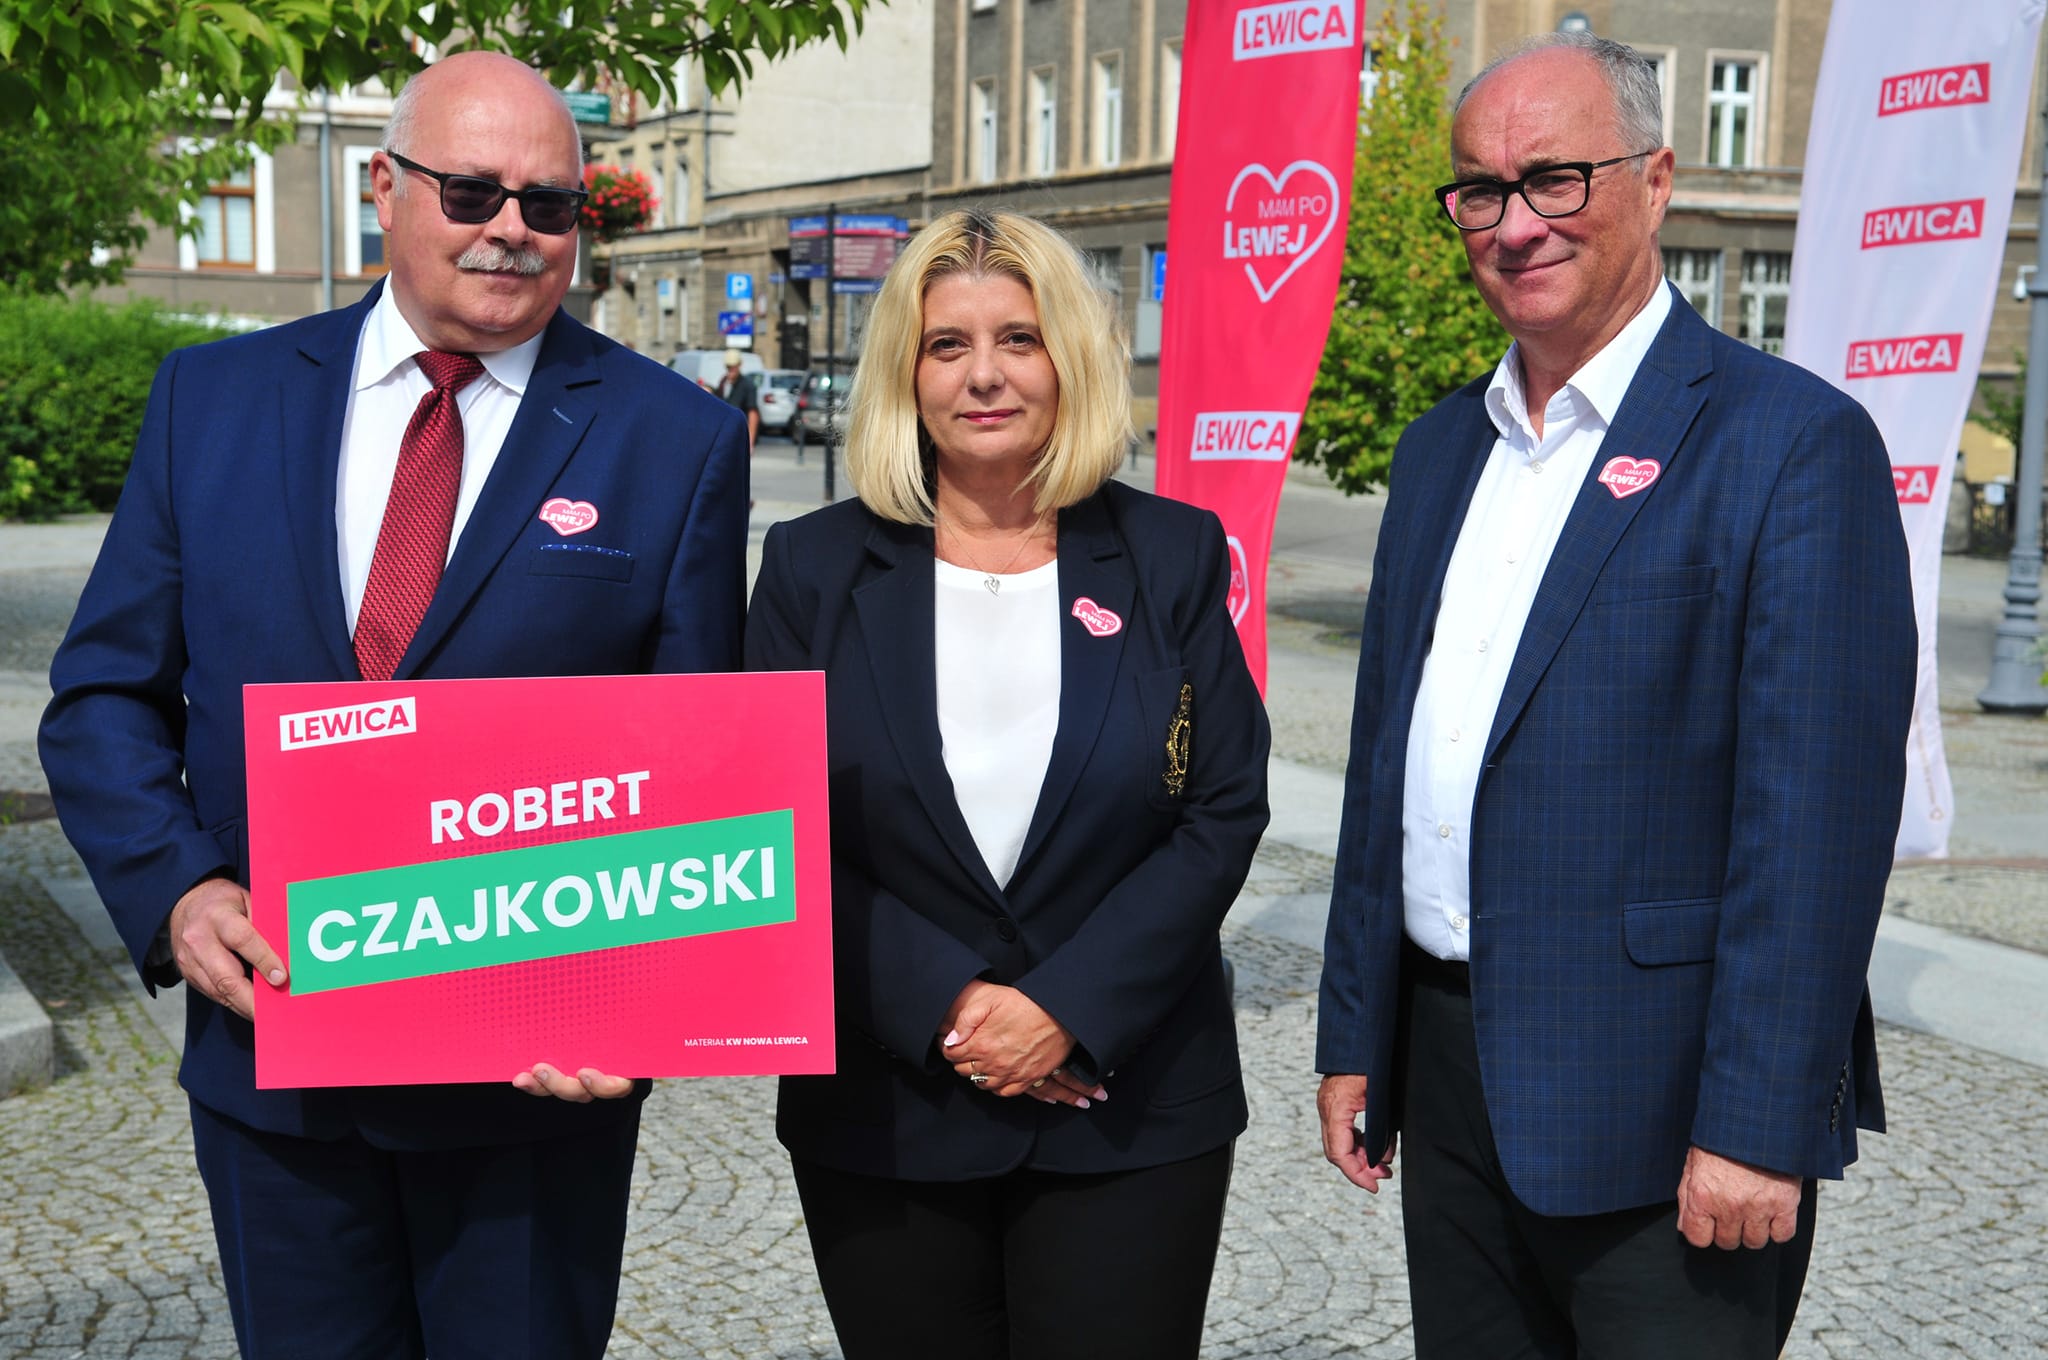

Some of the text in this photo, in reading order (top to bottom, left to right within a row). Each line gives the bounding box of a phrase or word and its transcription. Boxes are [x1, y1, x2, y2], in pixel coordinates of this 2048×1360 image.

[1242, 5, 1347, 50] LEWICA
[1883, 69, 1983, 111] LEWICA
[1258, 195, 1327, 218] MAM PO
[1866, 204, 1976, 243] LEWICA
[1224, 220, 1307, 258] LEWEJ
[1196, 418, 1286, 451] LEWICA
[289, 704, 410, 743] LEWICA
[430, 770, 650, 844] ROBERT
[307, 846, 776, 962] CZAJKOWSKI
[726, 1037, 742, 1046] KW
[743, 1037, 773, 1046] NOWA
[774, 1036, 808, 1045] LEWICA
